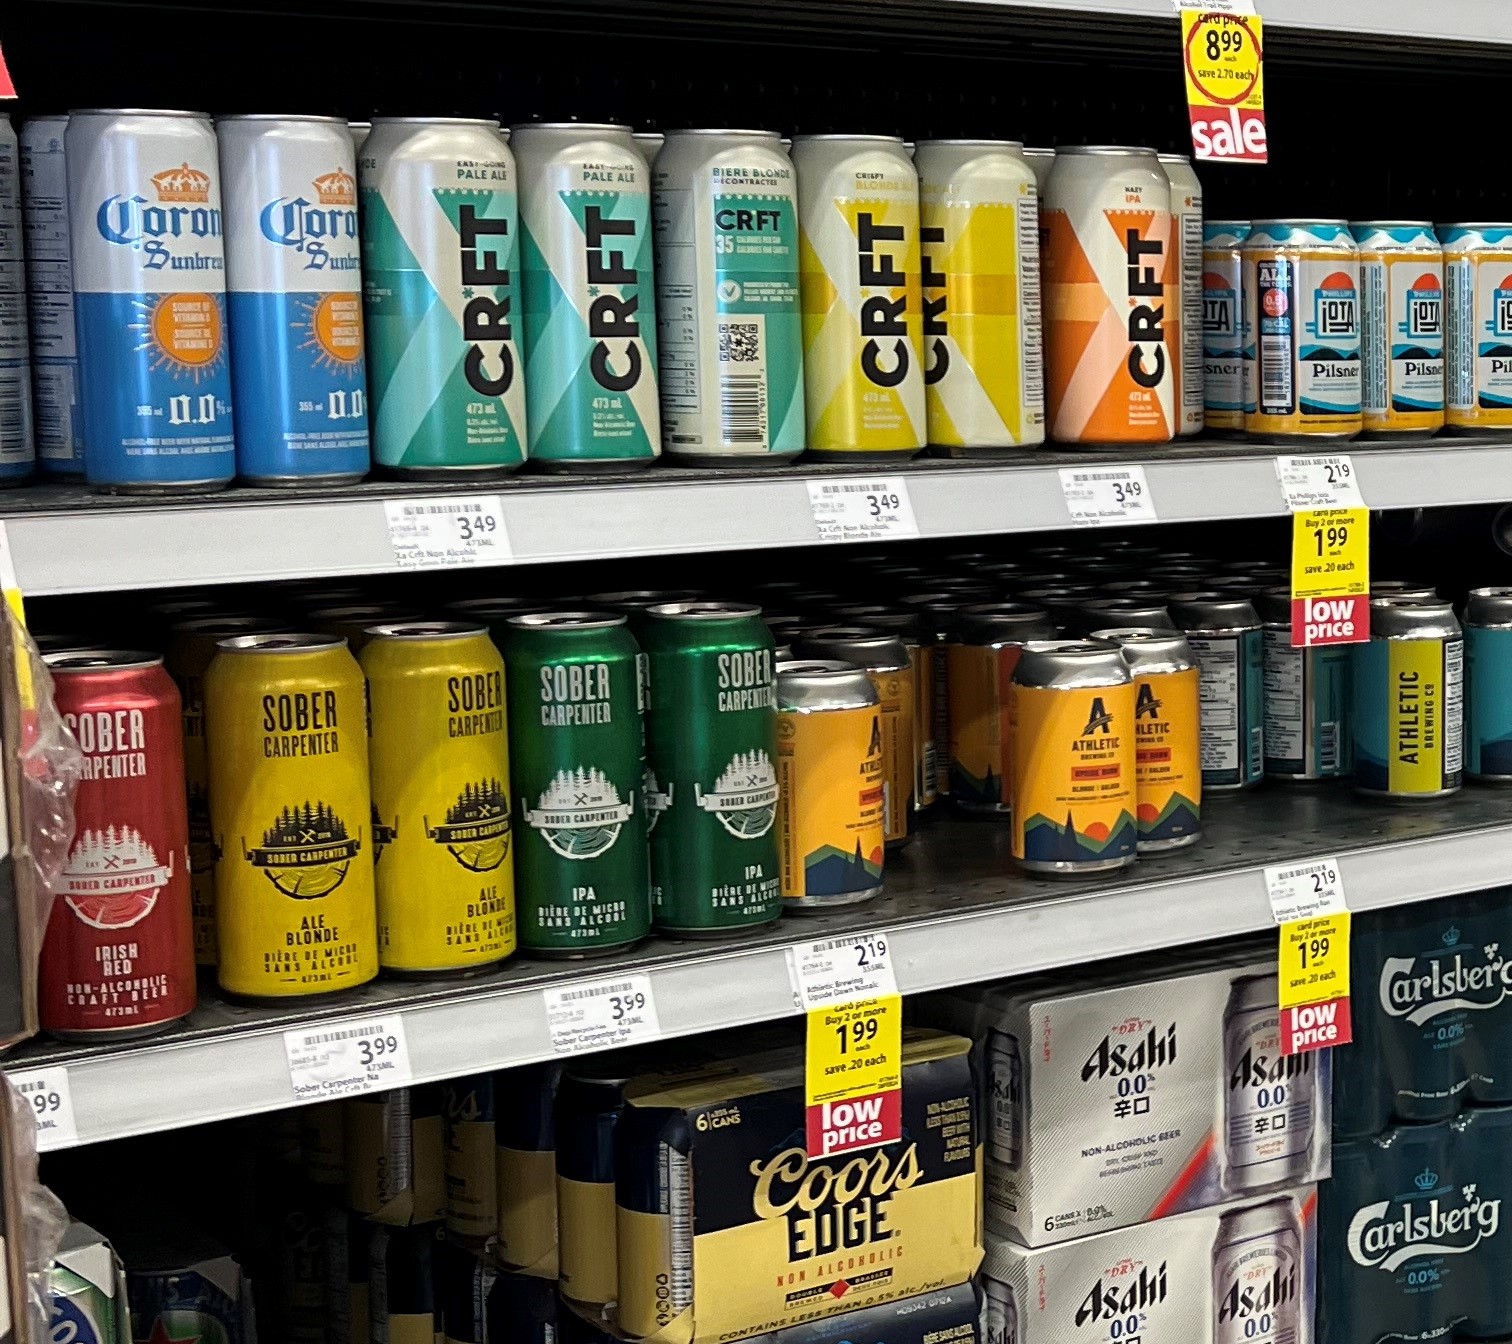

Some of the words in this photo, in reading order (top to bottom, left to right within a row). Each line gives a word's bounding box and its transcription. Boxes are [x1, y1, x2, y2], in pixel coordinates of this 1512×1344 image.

[1192, 113, 1268, 158] sale
[456, 169, 488, 182] PALE
[489, 170, 508, 183] ALE
[712, 166, 750, 179] BIÈRE
[752, 167, 792, 180] BLONDE
[96, 193, 223, 253] Coron
[714, 234, 735, 254] 35
[458, 204, 515, 398] CRFT
[584, 204, 642, 393] CRFT
[856, 212, 909, 389] CRFT
[1126, 227, 1166, 390] CRFT
[1312, 360, 1360, 380] Pilsner
[1304, 597, 1355, 624] low
[1304, 620, 1355, 646] price
[539, 663, 610, 702] SOBER
[717, 648, 772, 689] SOBER
[262, 691, 338, 732] SOBER
[541, 700, 612, 726] CARPENTER
[1399, 670, 1420, 766] ATHLETIC
[1424, 702, 1436, 749] BREWING
[263, 731, 340, 759] CARPENTER
[1070, 736, 1121, 753] ATHLETIC
[744, 864, 764, 881] IPA
[572, 886, 597, 902] IPA
[286, 926, 340, 947] BLONDE
[301, 914, 326, 931] ALE
[96, 943, 139, 963] IRISH
[104, 959, 133, 976] RED
[1080, 1020, 1178, 1083] Asahi
[1290, 1025, 1339, 1055] price
[821, 1096, 884, 1131] low
[822, 1120, 883, 1155] price
[1080, 1135, 1156, 1159] NON-ALCOHOLIC
[749, 1140, 925, 1222] Coors
[786, 1189, 895, 1263] EDGE
[1347, 1196, 1502, 1272] Carlsberg
[776, 1268, 808, 1289] NON
[817, 1244, 904, 1278] ALCOHOLIC
[1074, 1260, 1168, 1329] Asahi
[1218, 1262, 1297, 1326] Asahi
